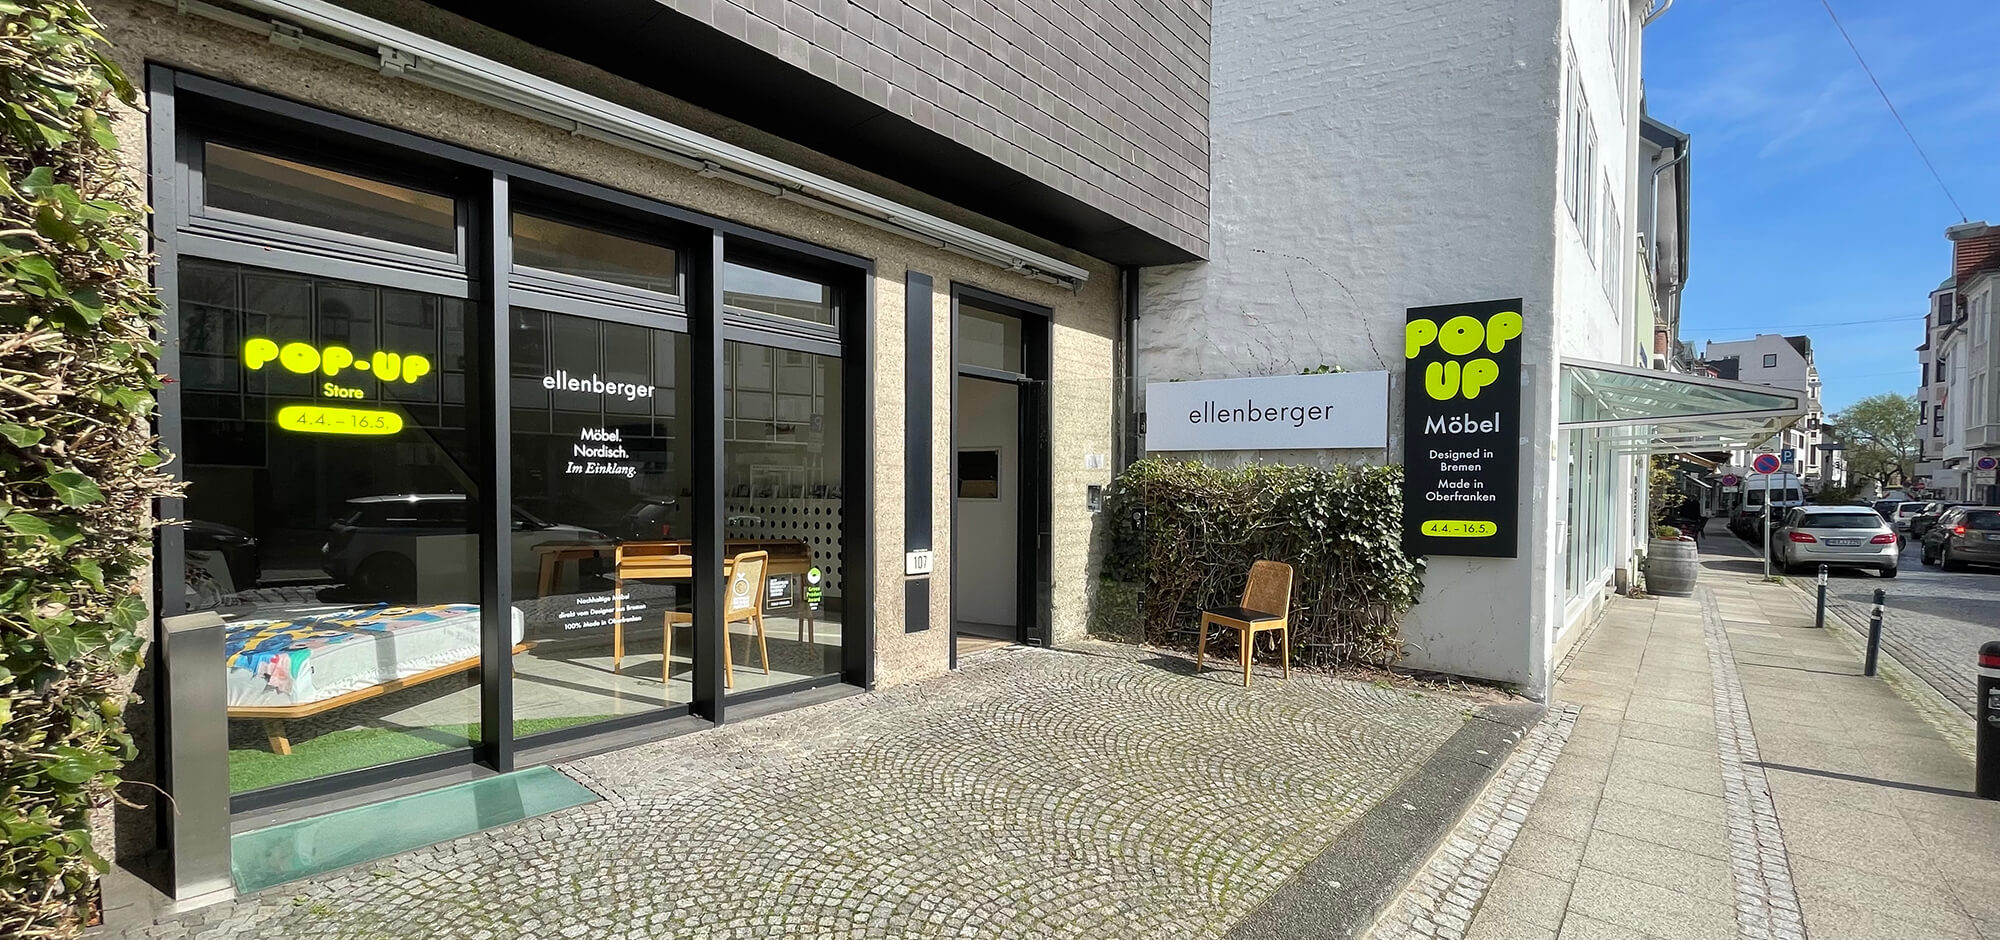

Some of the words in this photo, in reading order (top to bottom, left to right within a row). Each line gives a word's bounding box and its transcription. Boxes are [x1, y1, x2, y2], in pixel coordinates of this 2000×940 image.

[1405, 311, 1523, 359] POP
[245, 338, 430, 383] POP-UP
[543, 369, 655, 401] ellenberger
[1425, 358, 1499, 400] UP
[323, 382, 364, 399] Store
[296, 412, 331, 426] 4.4.
[350, 414, 389, 430] 16.5.
[1189, 399, 1334, 427] ellenberger
[1424, 412, 1500, 434] Möbel
[580, 427, 622, 442] Möbel.
[573, 444, 629, 459] Nordisch.
[1429, 448, 1480, 461] Designed
[1483, 449, 1494, 459] in
[565, 461, 583, 474] Im
[585, 462, 637, 478] Einklang.
[1440, 462, 1481, 472] Bremen
[1438, 479, 1470, 489] Made
[1473, 479, 1484, 489] in
[1425, 491, 1496, 501] Oberfranken
[1430, 524, 1451, 532] 4.4.
[1463, 524, 1488, 533] 16.5.
[914, 555, 927, 569] 107
